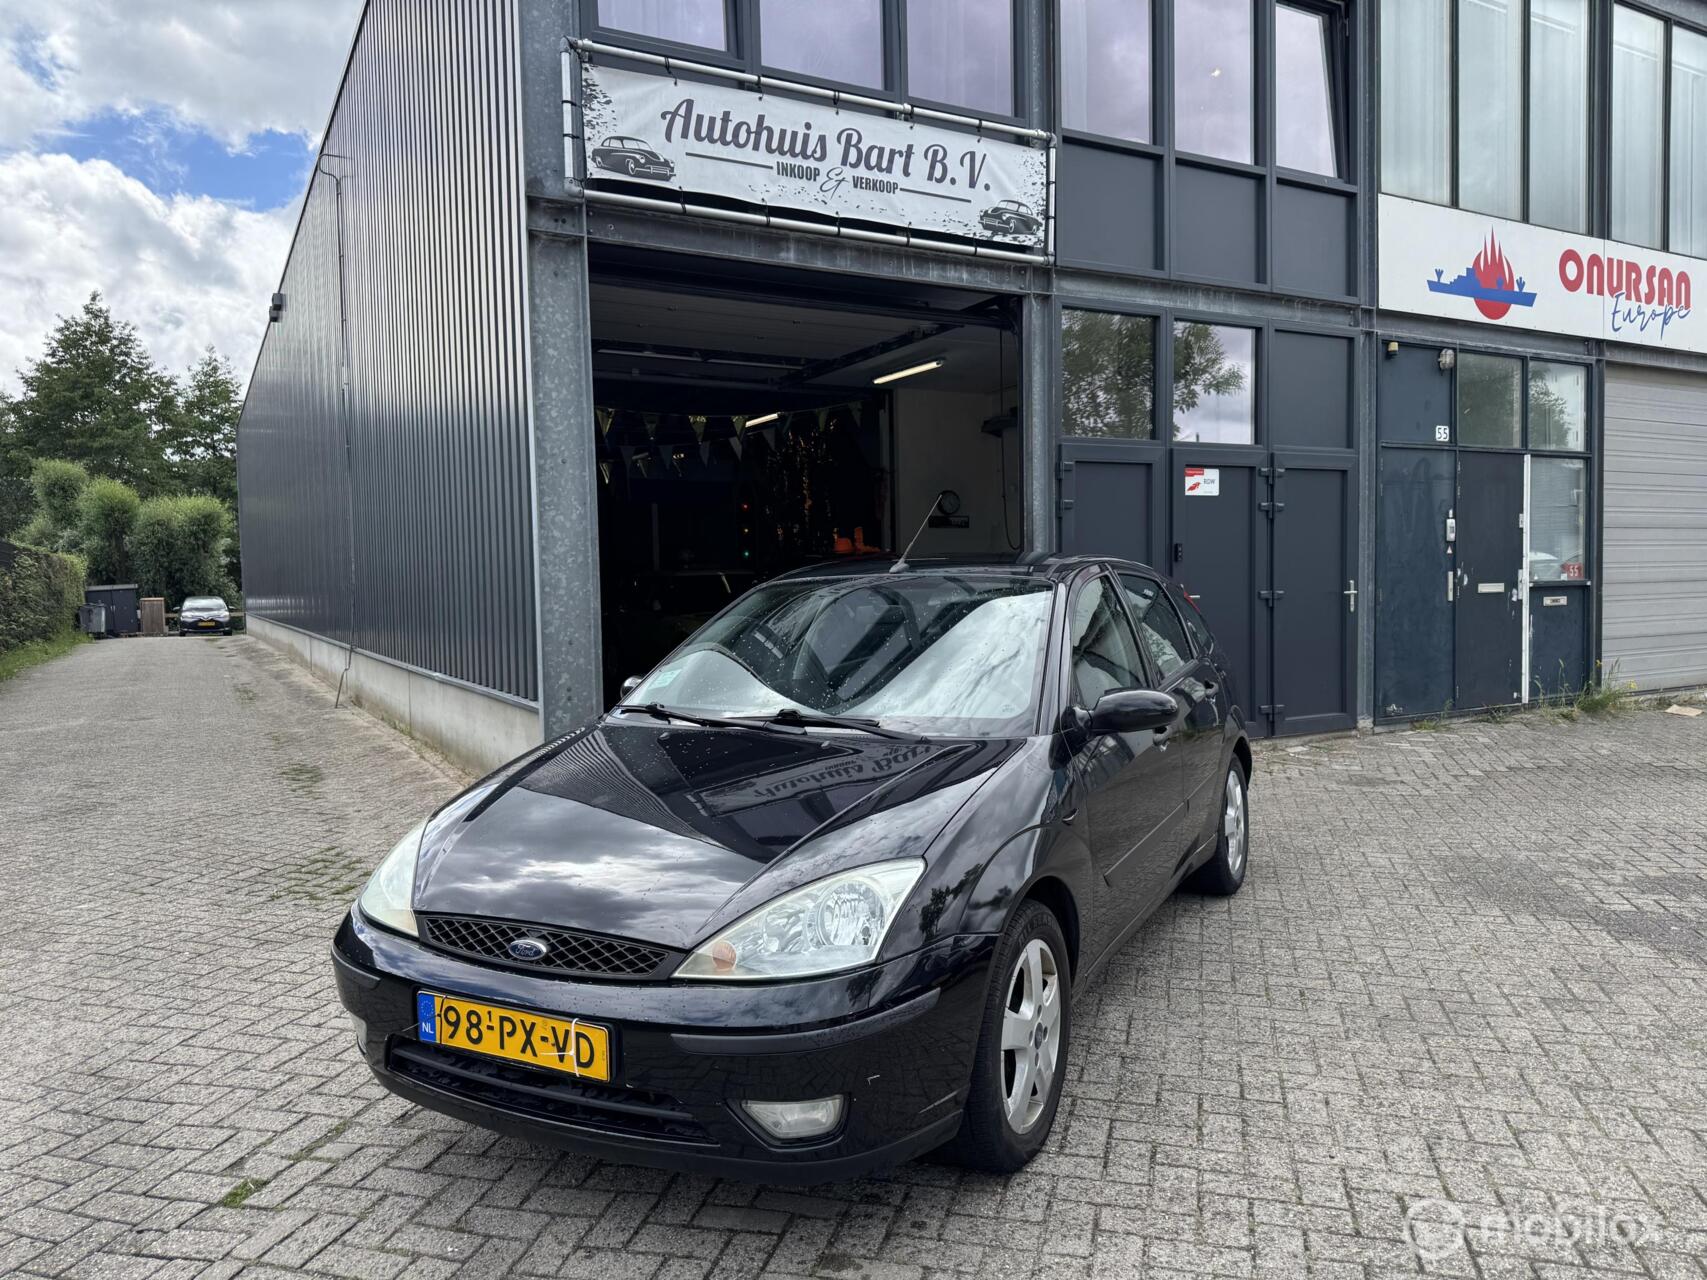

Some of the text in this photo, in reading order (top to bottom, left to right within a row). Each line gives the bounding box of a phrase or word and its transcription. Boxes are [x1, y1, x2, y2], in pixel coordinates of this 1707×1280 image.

[660, 98, 991, 191] Autohuis Bart B.V.
[776, 161, 899, 199] INKOOP & VERKOOP
[1559, 248, 1691, 310] ONURSAN
[1611, 292, 1691, 340] Europe
[1437, 427, 1448, 440] 55
[515, 943, 537, 957] Ford
[422, 1022, 434, 1035] NL
